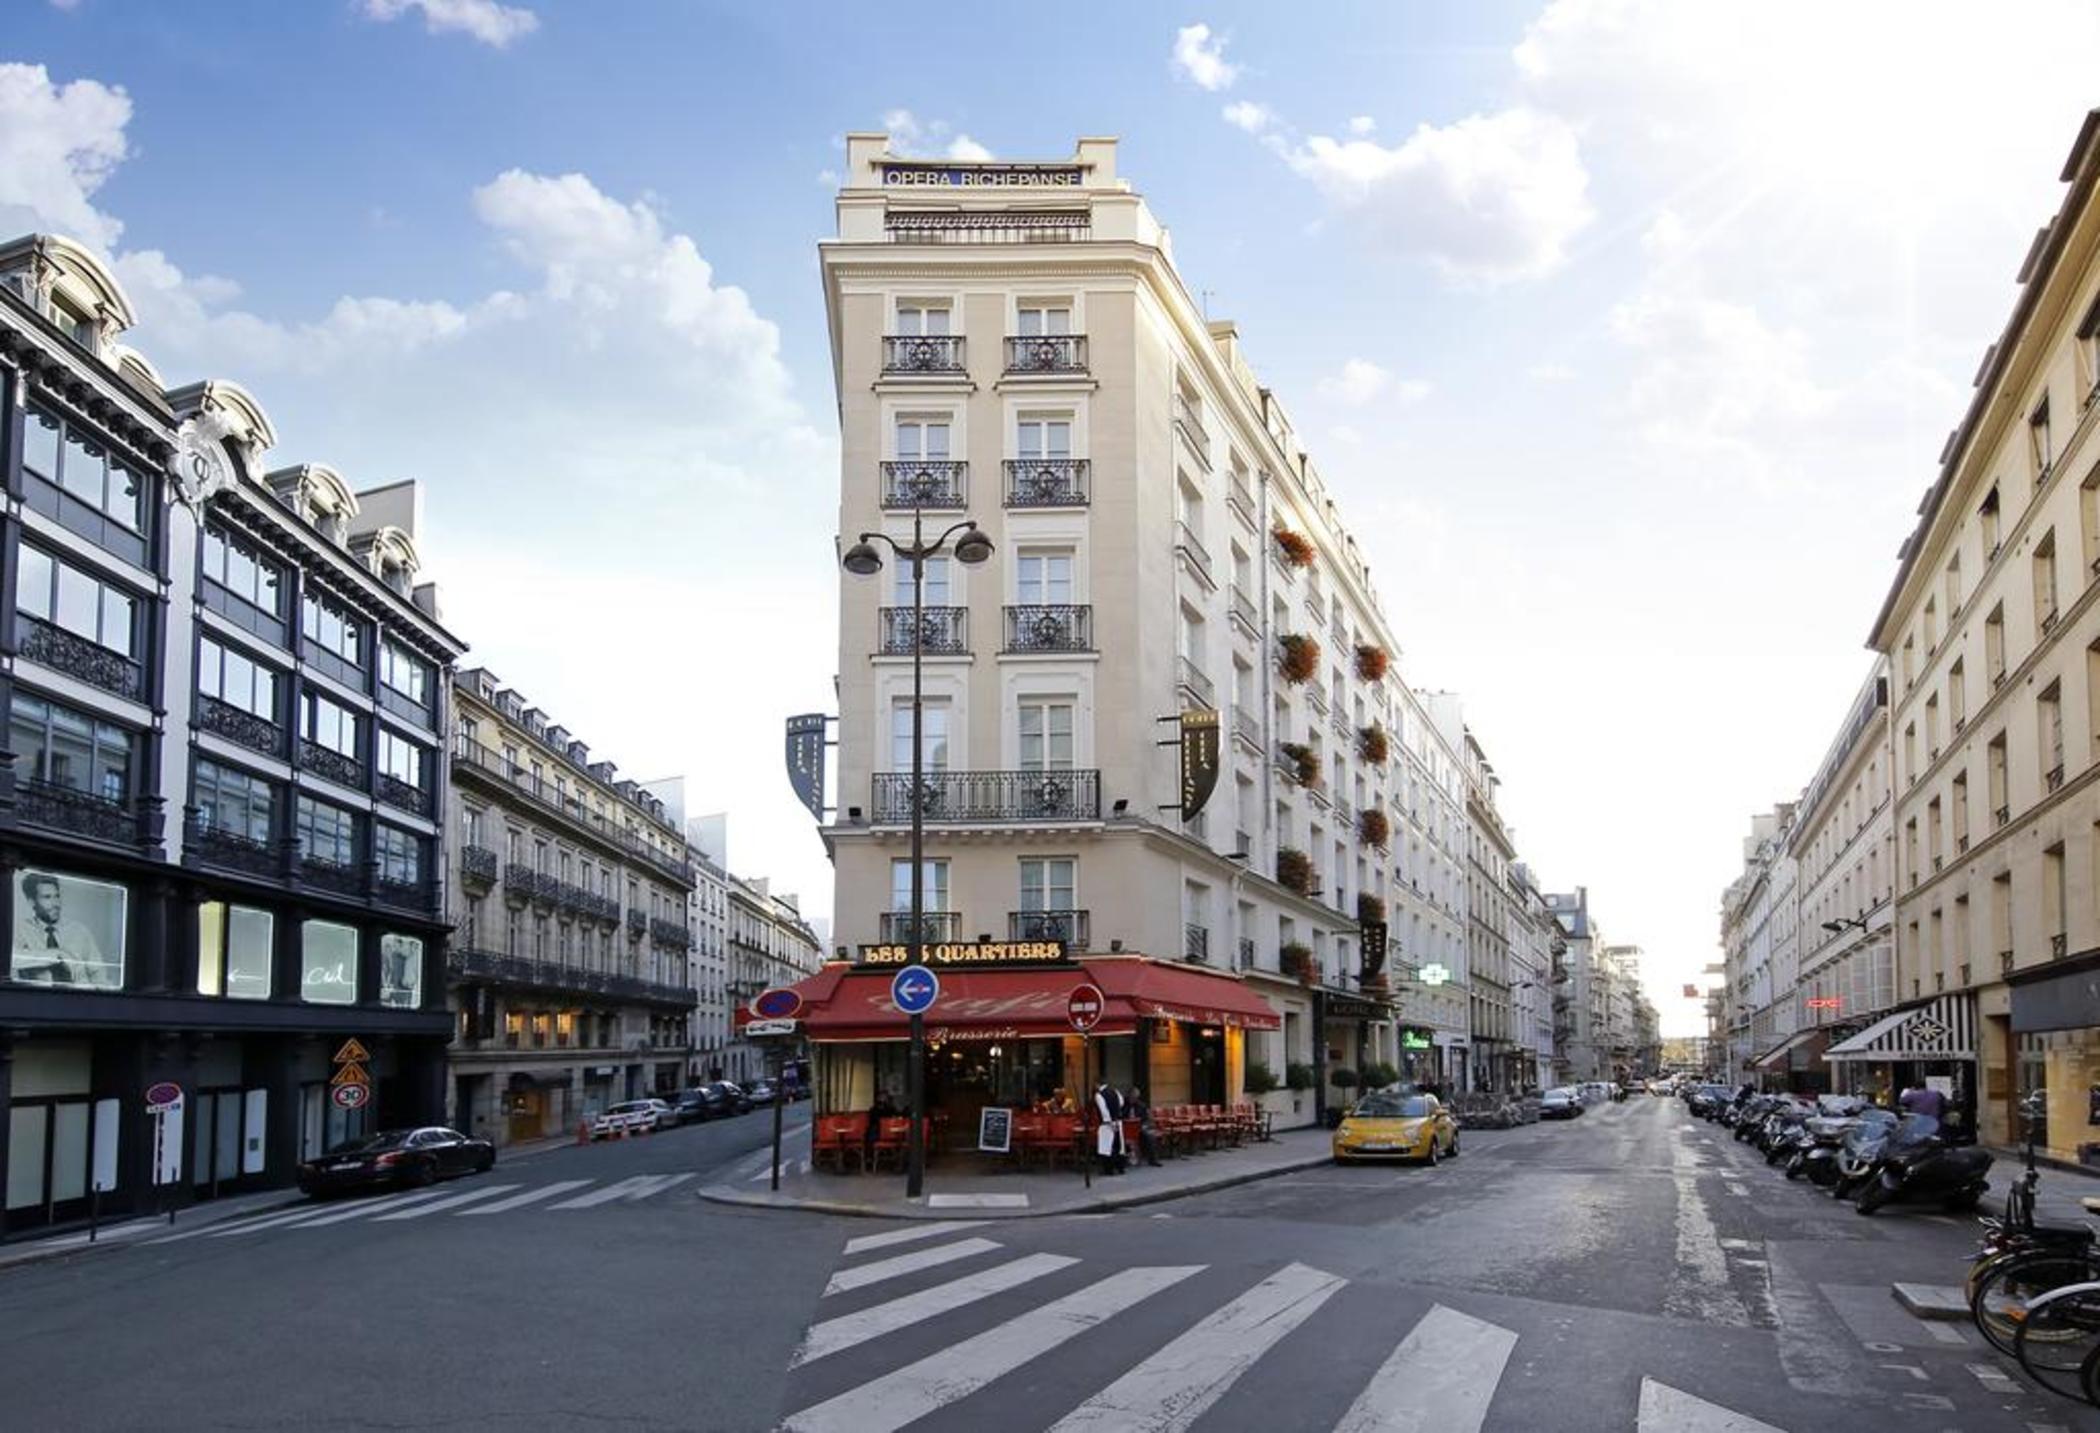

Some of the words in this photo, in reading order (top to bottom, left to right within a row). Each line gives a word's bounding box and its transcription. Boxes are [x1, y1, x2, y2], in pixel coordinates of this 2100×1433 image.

[887, 171, 950, 185] OPERA
[961, 172, 1079, 186] RICHEPANSE
[865, 946, 907, 962] LES
[936, 943, 1061, 962] QUARTIERS
[926, 1027, 1020, 1044] Brasserie
[343, 1090, 361, 1101] 30
